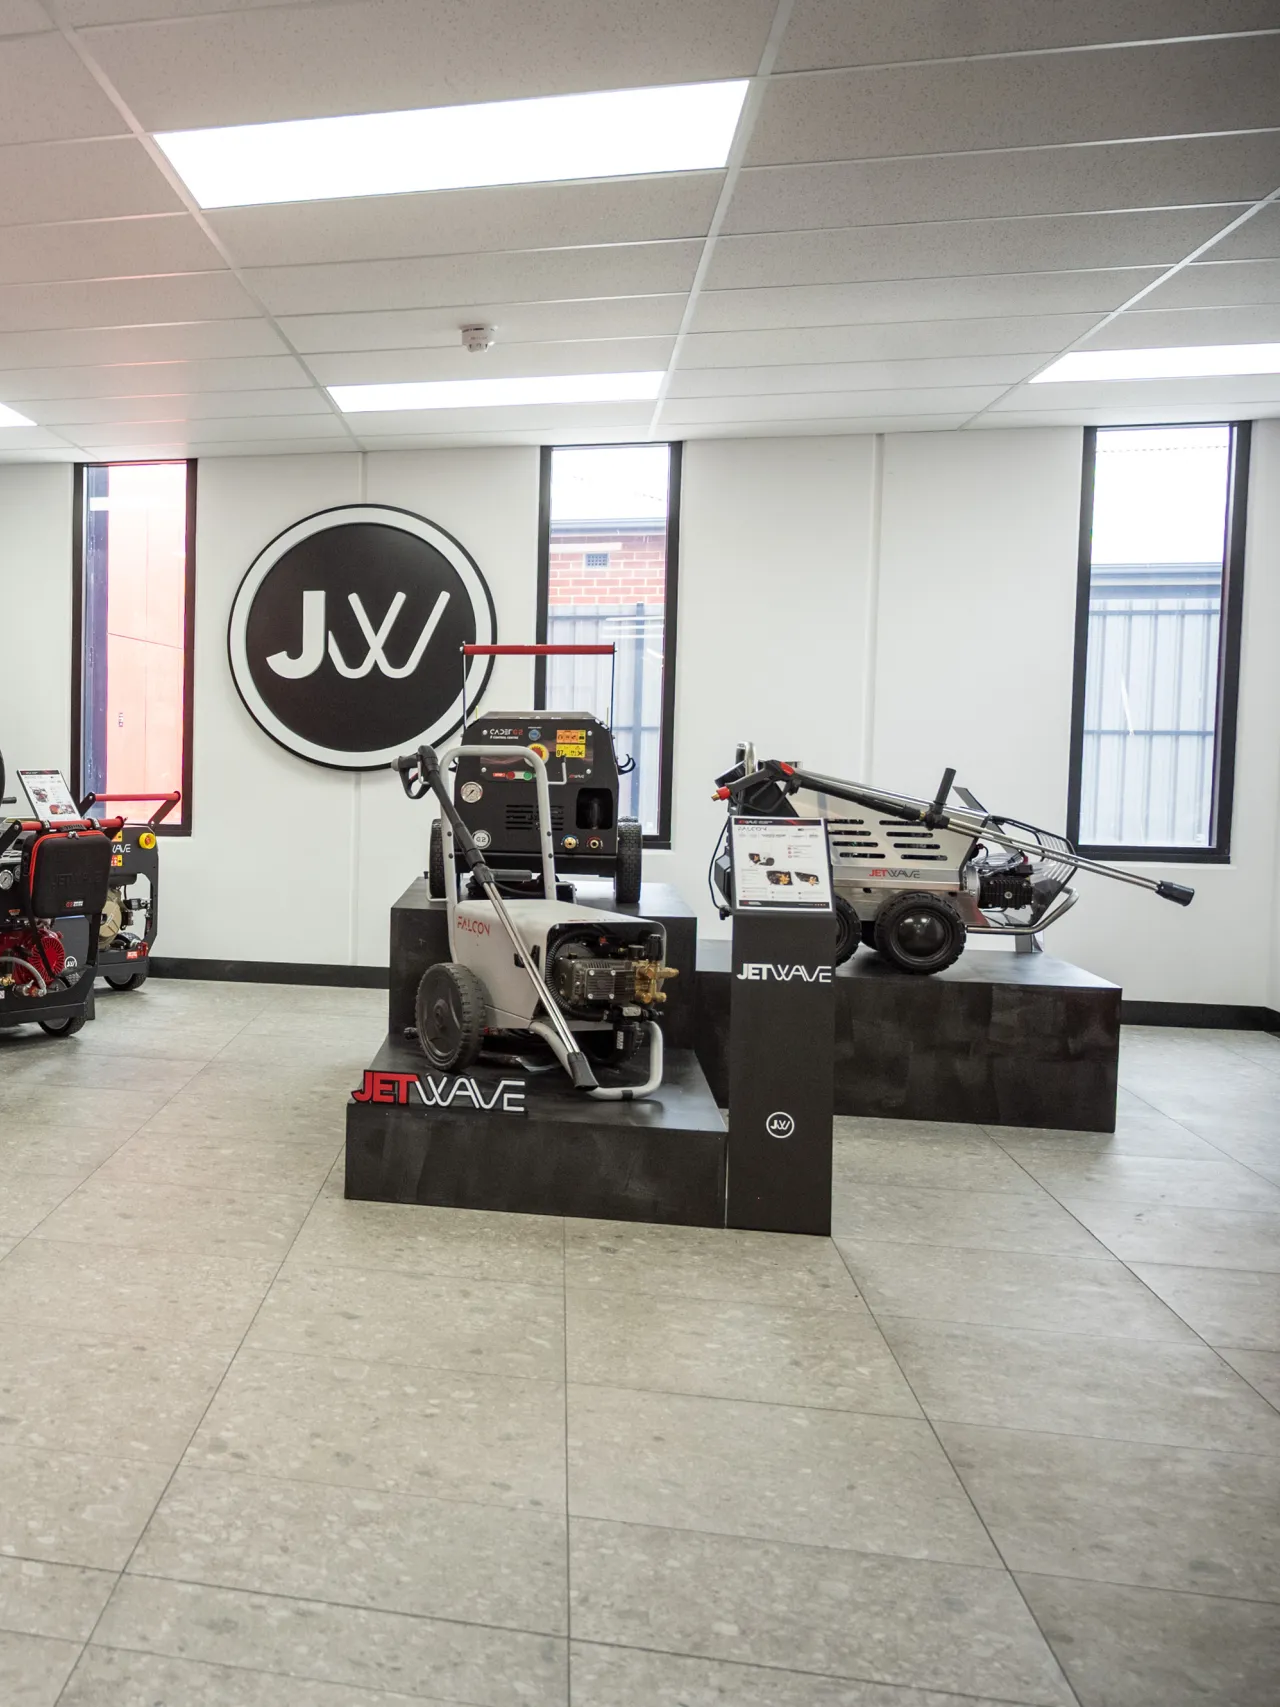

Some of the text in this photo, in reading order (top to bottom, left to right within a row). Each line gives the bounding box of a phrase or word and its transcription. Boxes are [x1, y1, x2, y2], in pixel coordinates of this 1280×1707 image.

[266, 590, 451, 679] JW
[868, 868, 921, 879] JETWAVE
[457, 916, 491, 936] FALCON
[736, 963, 832, 983] JETWAVE
[352, 1071, 526, 1112] JETWAVE
[769, 1119, 790, 1130] JW
